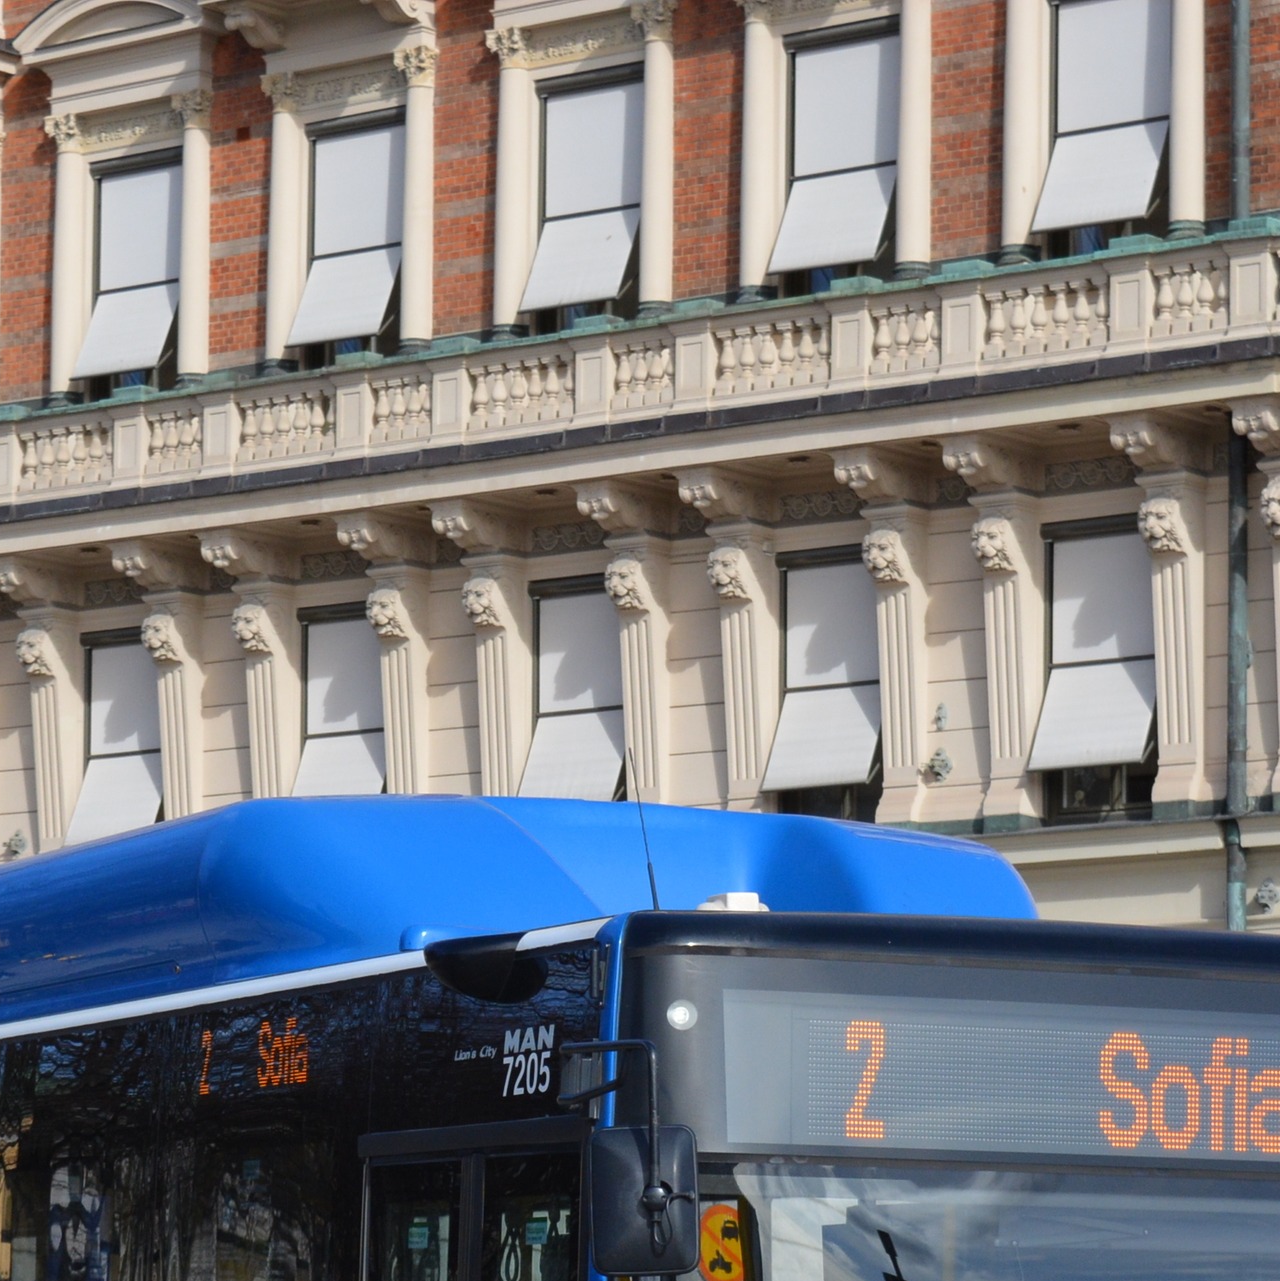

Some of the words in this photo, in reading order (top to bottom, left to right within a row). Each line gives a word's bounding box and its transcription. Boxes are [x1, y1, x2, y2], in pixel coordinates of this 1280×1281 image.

[199, 1029, 213, 1095] 2
[256, 1017, 309, 1088] Sofia
[454, 1048, 477, 1061] Lion's
[479, 1045, 497, 1059] City
[503, 1024, 555, 1055] MAN
[502, 1050, 551, 1097] 7205
[845, 1020, 885, 1139] 2
